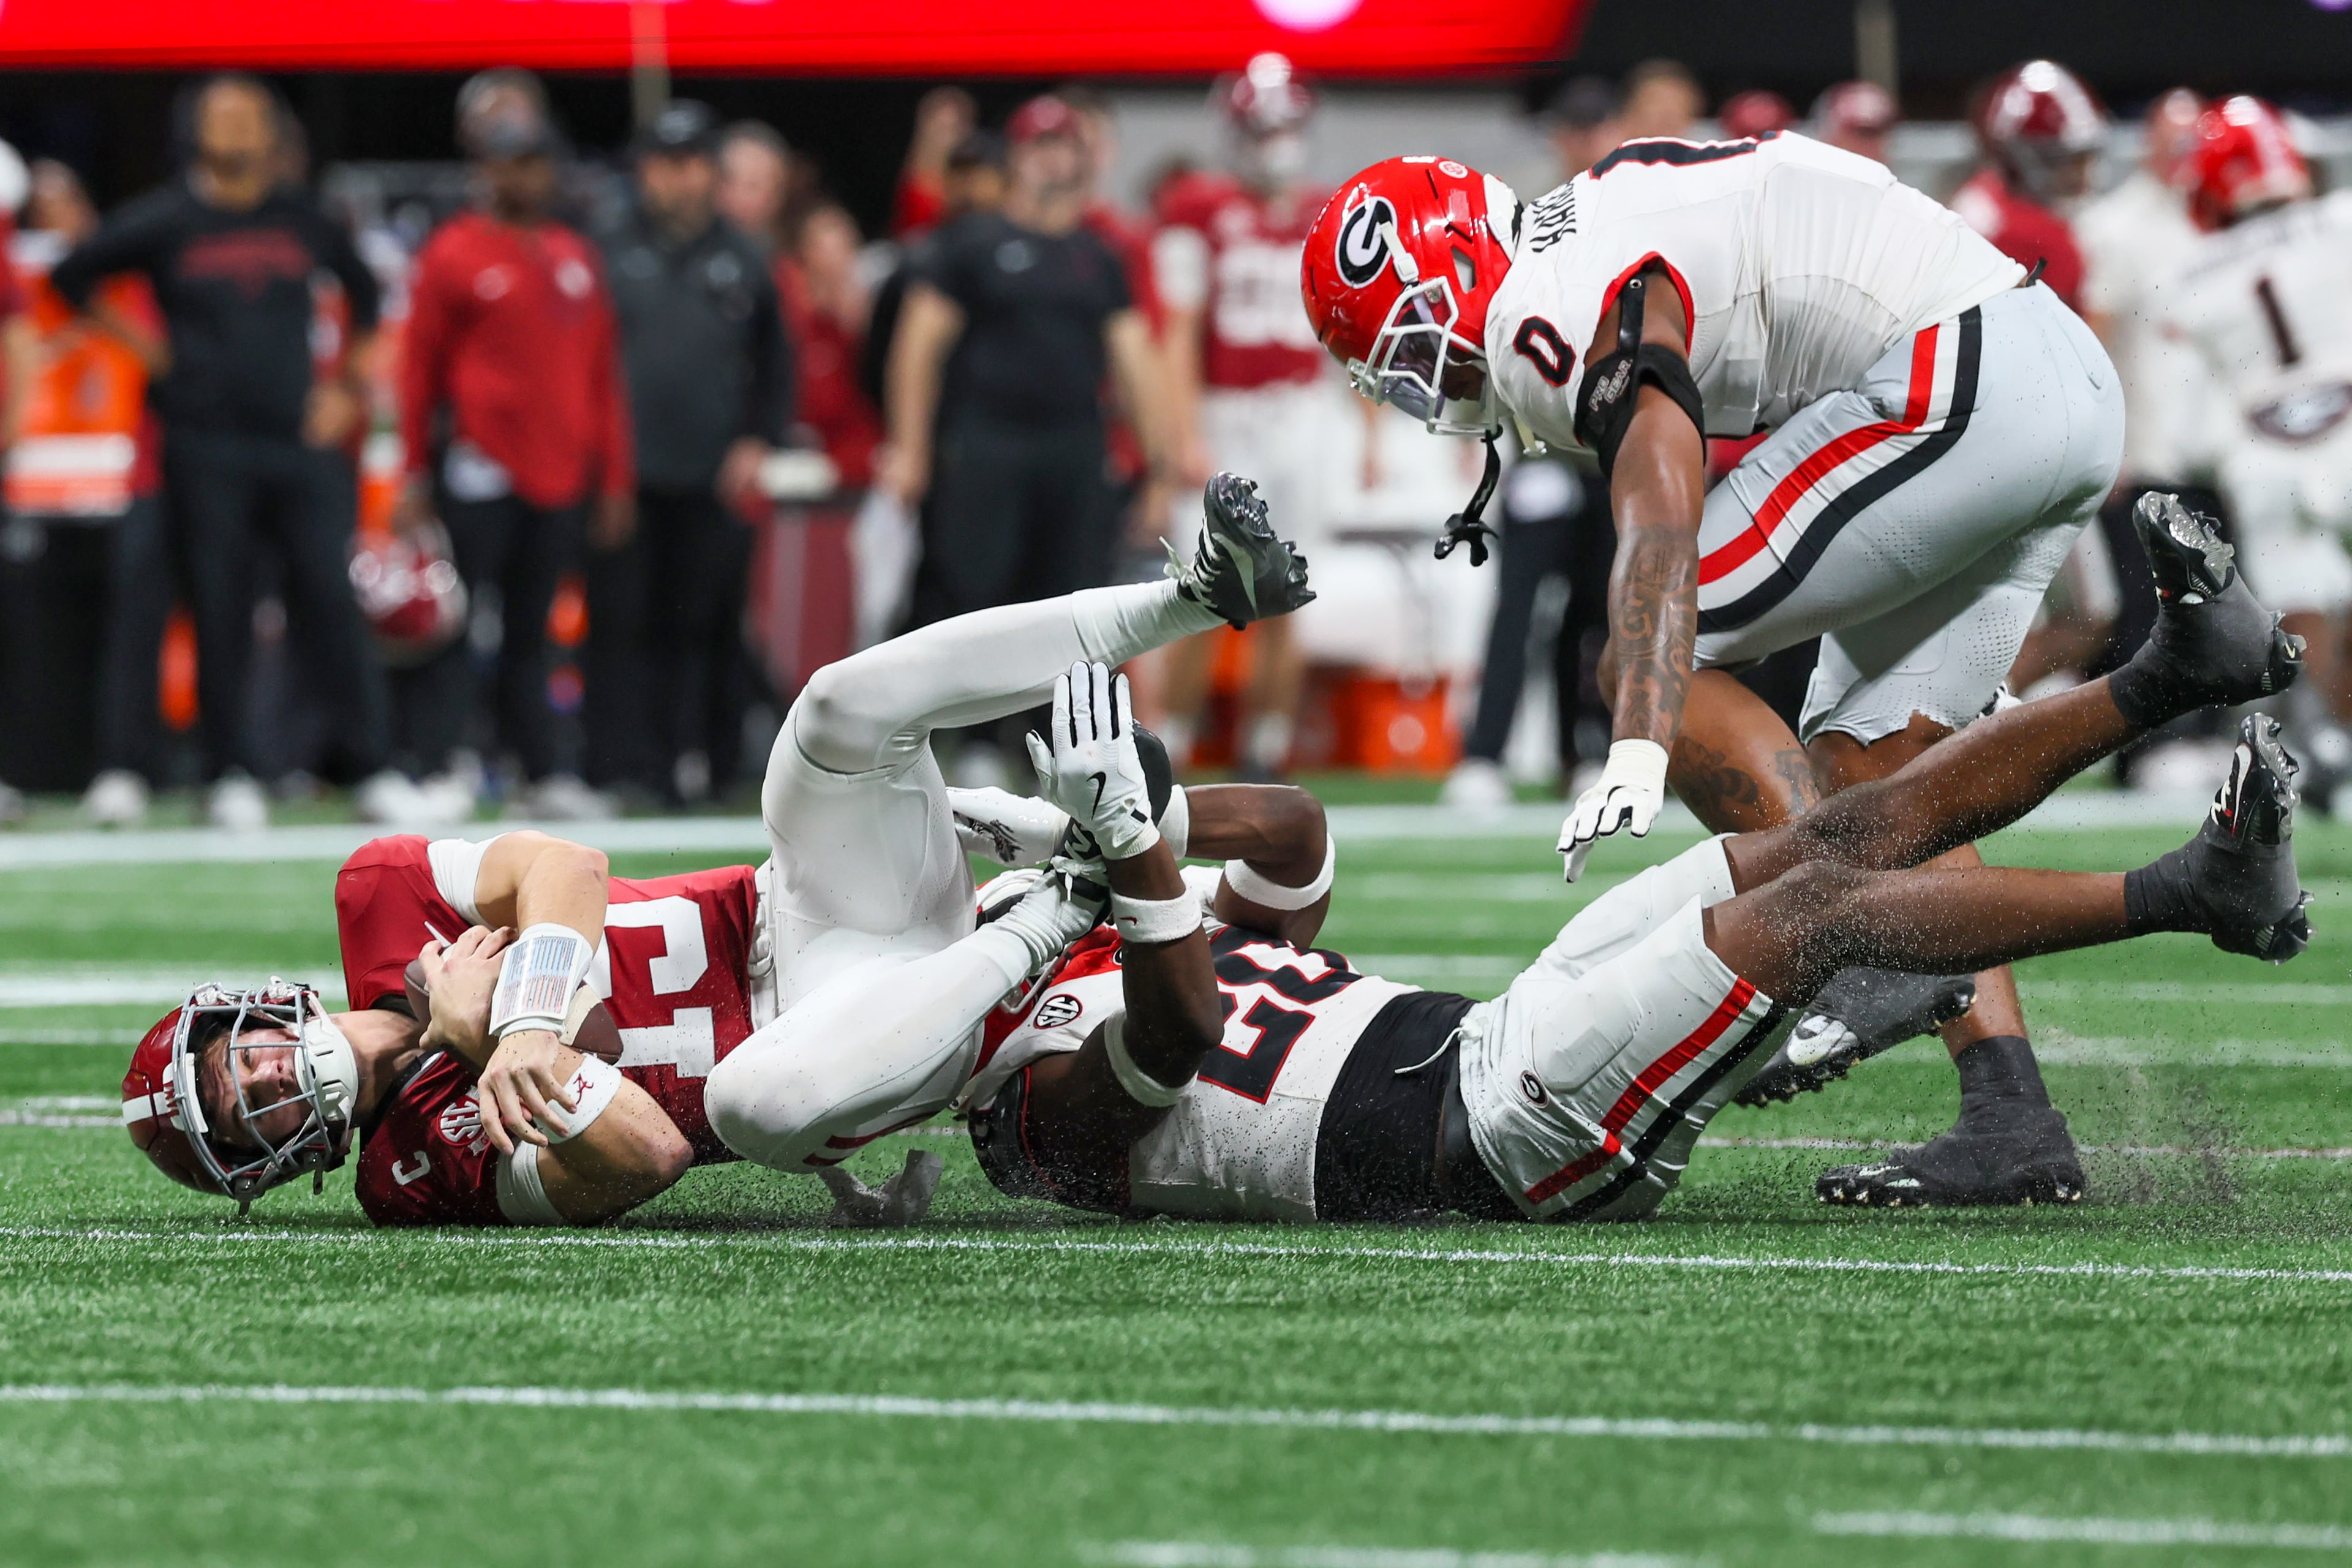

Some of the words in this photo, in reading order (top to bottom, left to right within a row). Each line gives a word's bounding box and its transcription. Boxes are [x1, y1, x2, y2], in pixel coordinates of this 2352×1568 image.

[1513, 315, 1577, 387] 0
[1588, 375, 1610, 412] PRO
[1036, 996, 1080, 1027] SEC
[440, 1100, 481, 1142] SEC
